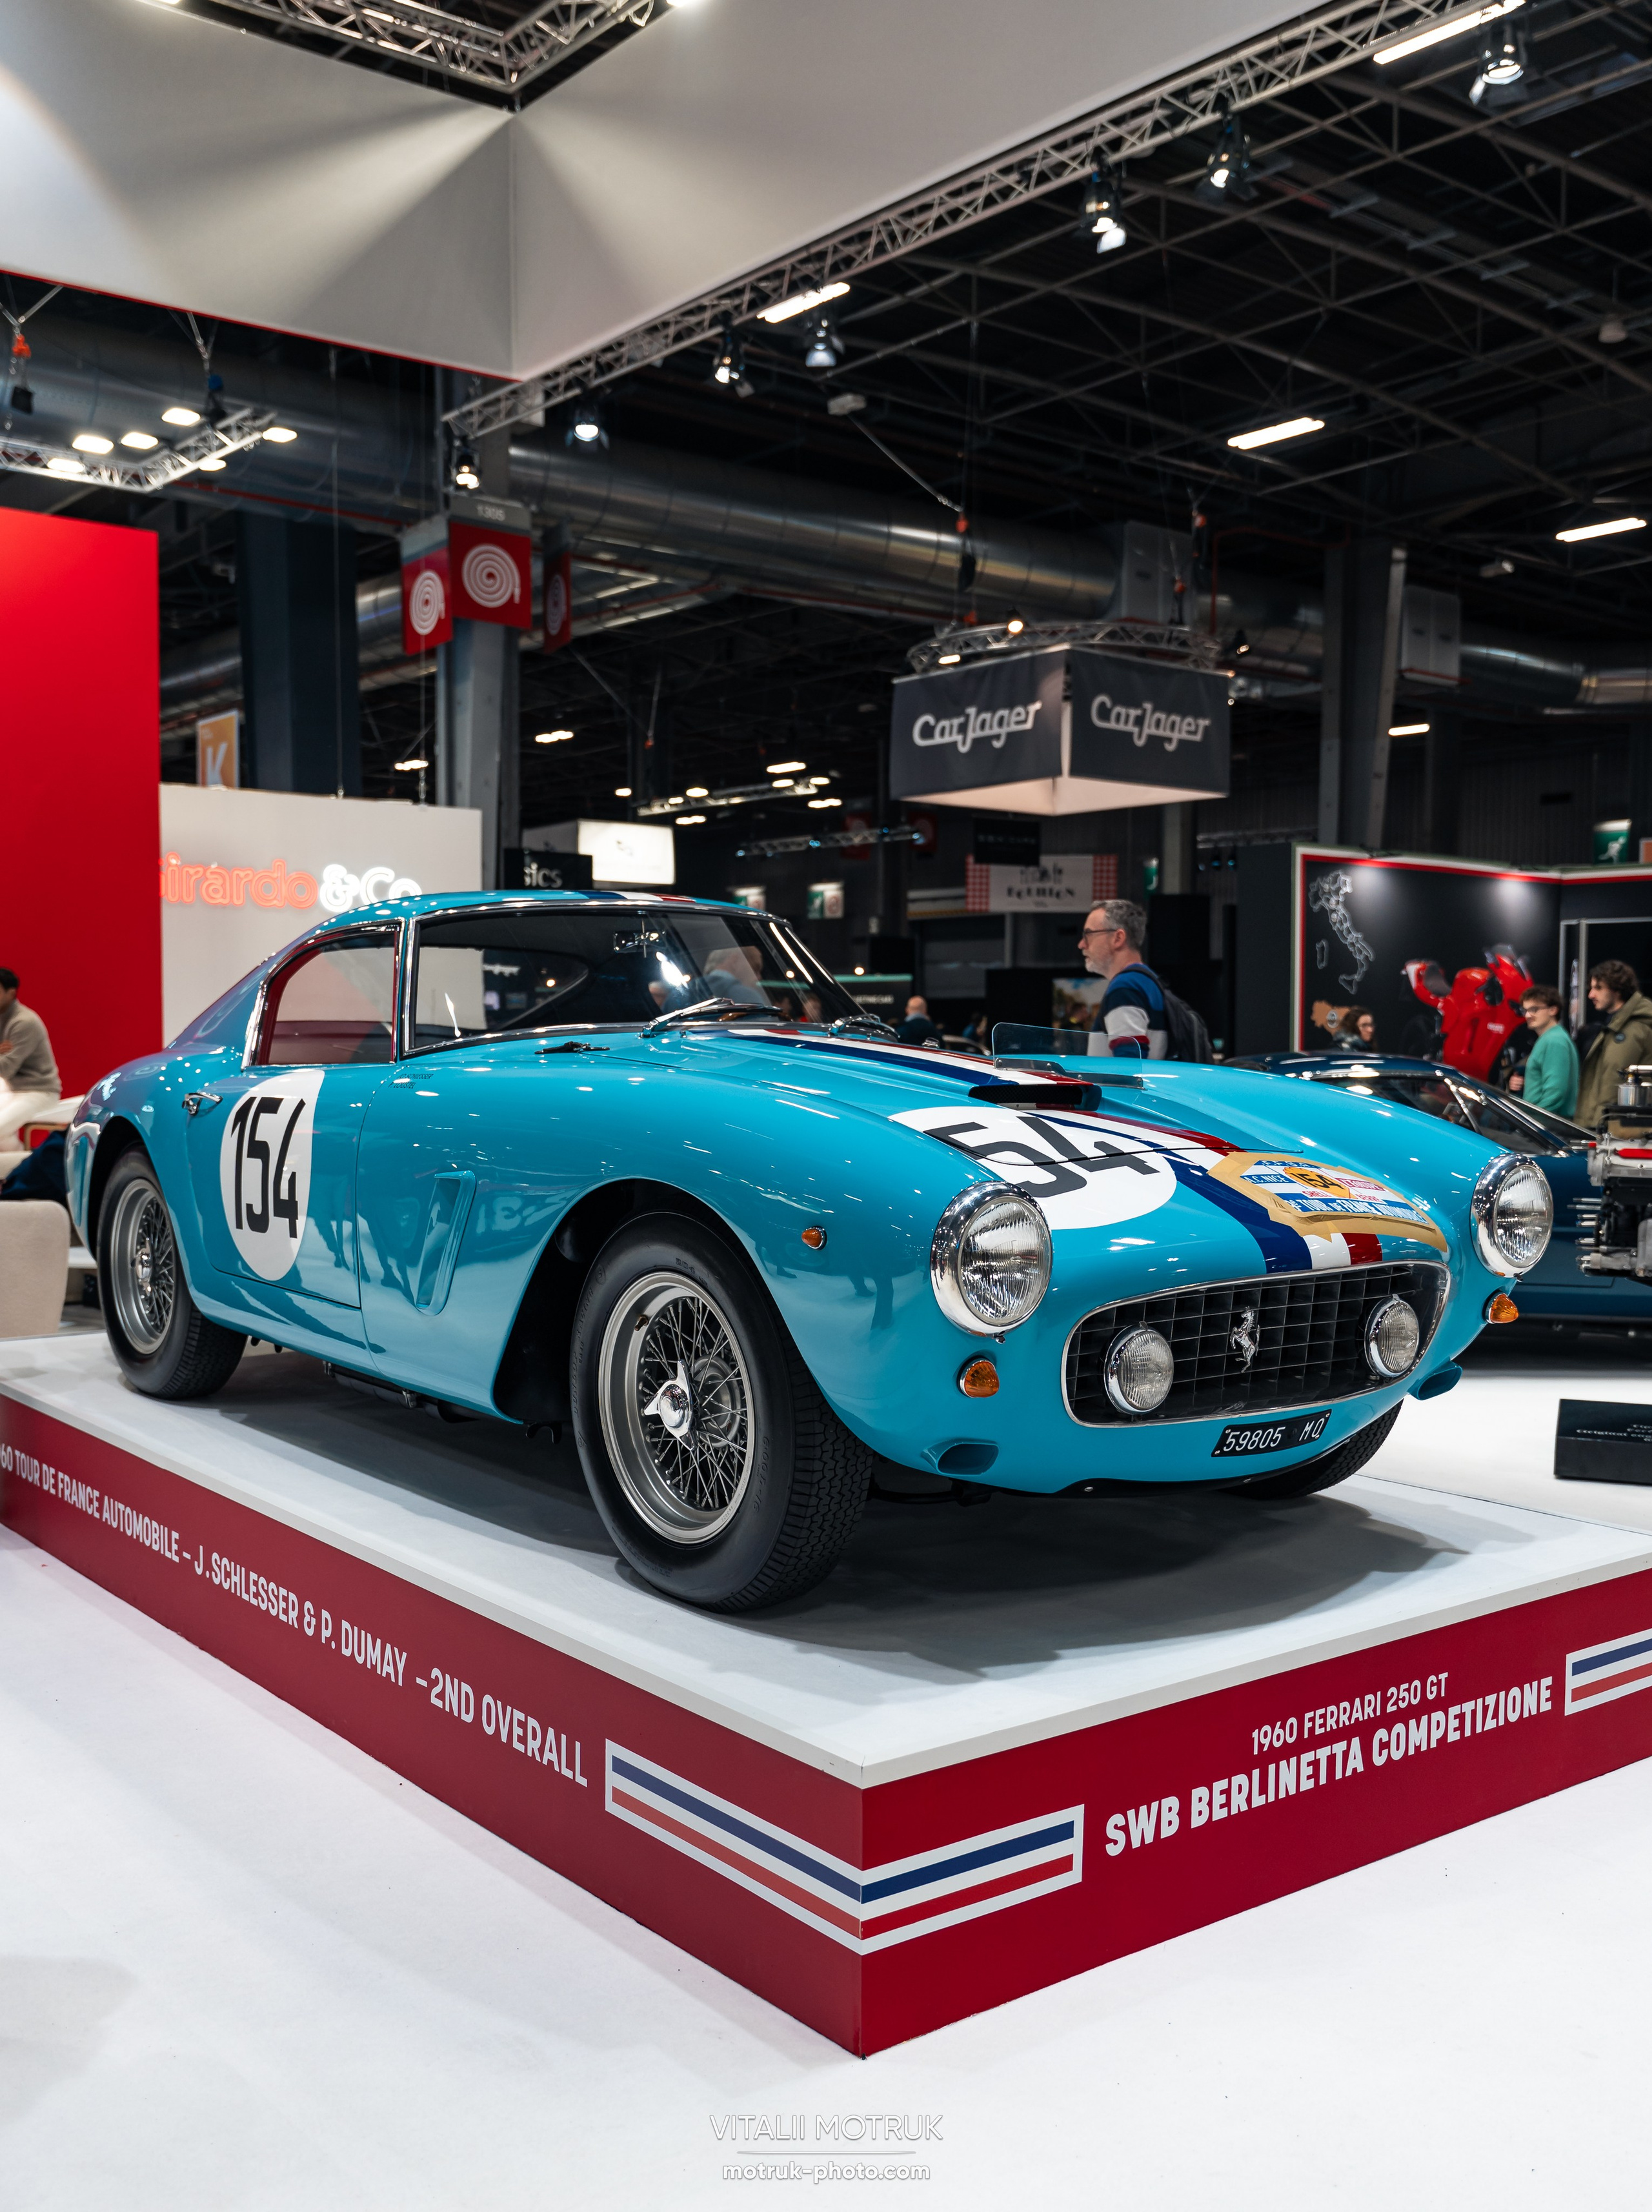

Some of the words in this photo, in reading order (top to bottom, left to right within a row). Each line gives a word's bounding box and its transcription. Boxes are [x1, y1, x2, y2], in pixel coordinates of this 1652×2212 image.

[912, 700, 1043, 753] CarJager
[1093, 696, 1209, 751] CarJager
[231, 1096, 306, 1239] 154
[1289, 1172, 1345, 1190] 154
[1295, 1200, 1335, 1211] TOUR
[1223, 1426, 1286, 1452] 59805
[1298, 1418, 1325, 1442] MO
[15, 1449, 40, 1486] TOUR
[42, 1463, 55, 1494] DE
[58, 1471, 100, 1519] FRANCE
[102, 1495, 179, 1563] AUTOMOBILE
[303, 1600, 316, 1636] &
[321, 1609, 336, 1649] P.
[341, 1619, 407, 1687] DUMAY
[481, 1694, 588, 1787] OVERALL
[1252, 1716, 1298, 1755] 1960
[1304, 1686, 1381, 1738] FERRARI
[1386, 1680, 1421, 1713] 250
[1426, 1671, 1449, 1700] GT
[1105, 1796, 1180, 1856] SWB
[1191, 1736, 1364, 1829] BERLINETTA
[1372, 1676, 1553, 1767] COMPETIZIONE
